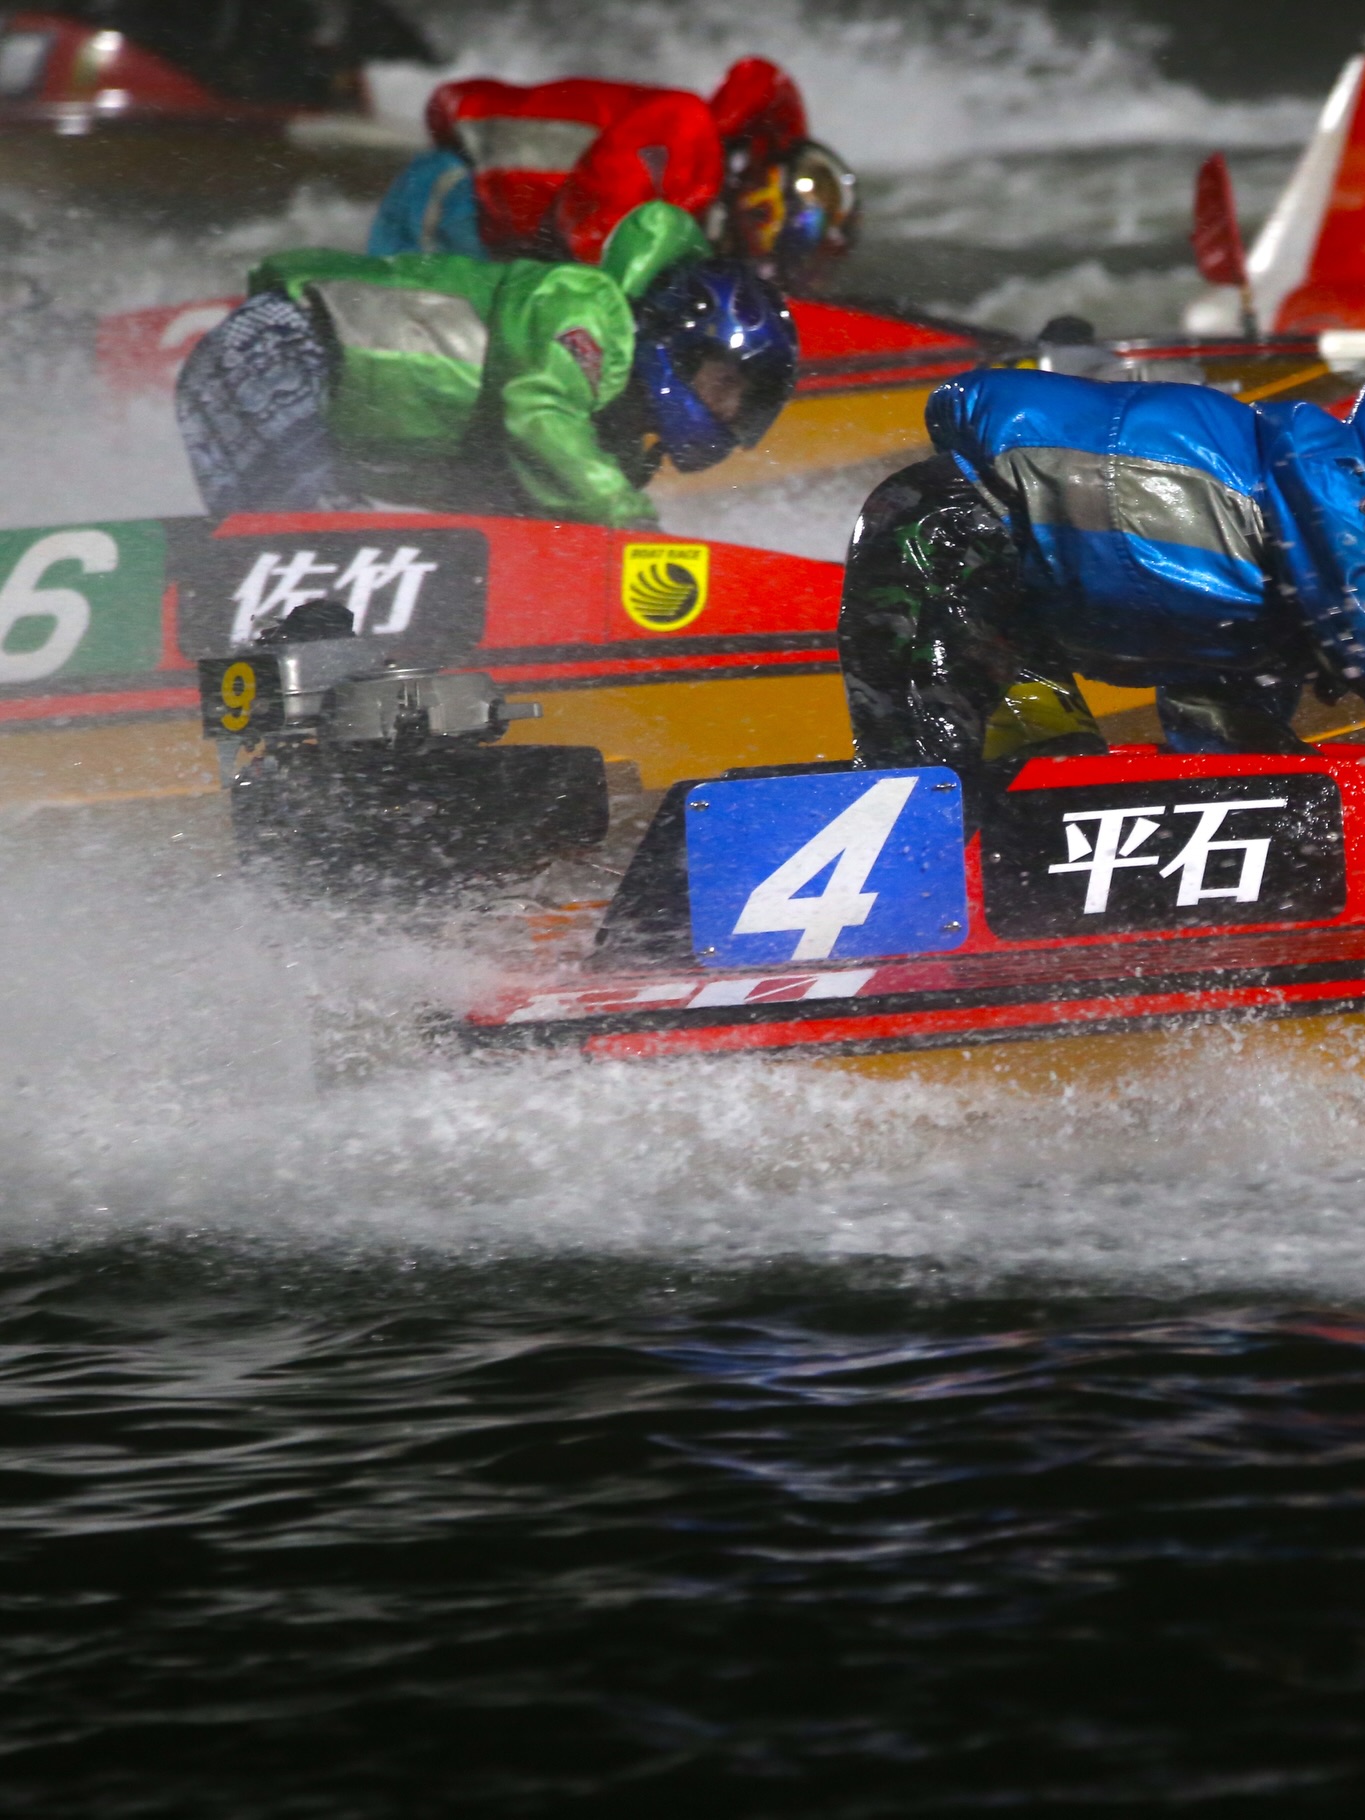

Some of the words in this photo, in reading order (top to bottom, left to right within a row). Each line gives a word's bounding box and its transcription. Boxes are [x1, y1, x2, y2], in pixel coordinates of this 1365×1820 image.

[0, 530, 118, 682] 6
[230, 547, 438, 648] 佐竹
[221, 662, 257, 731] 9
[732, 776, 919, 961] 4
[1048, 798, 1287, 914] 平石
